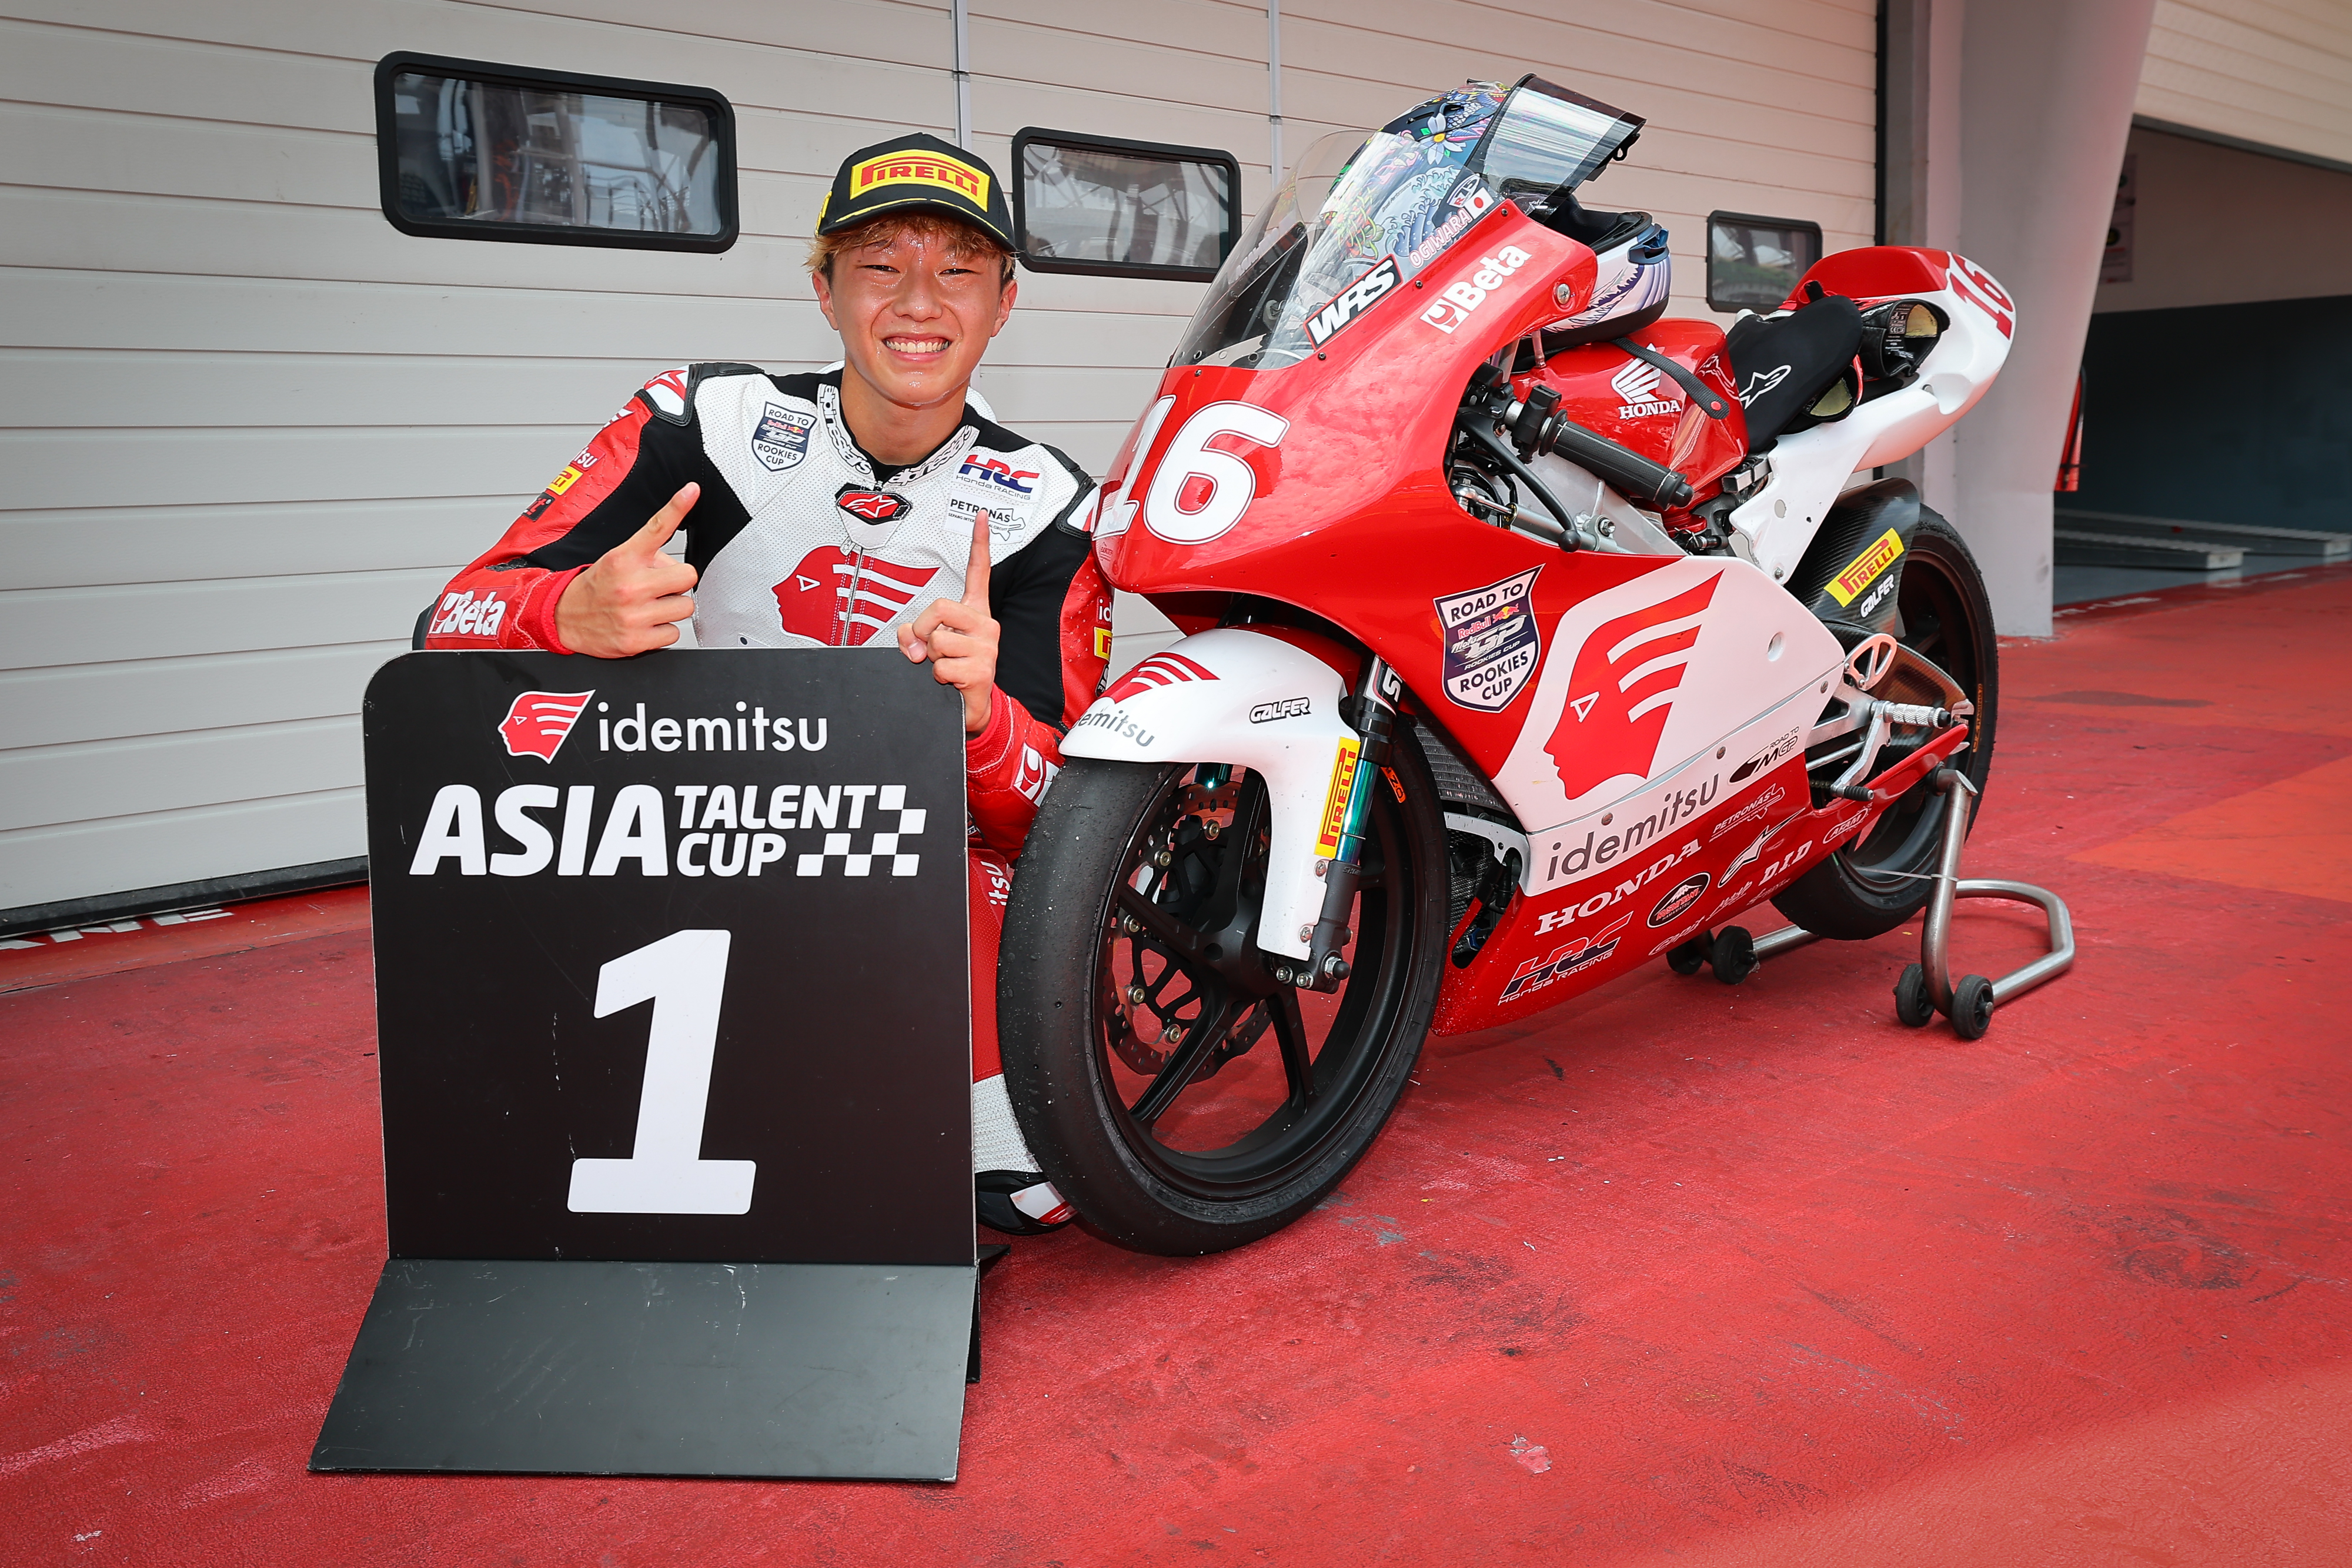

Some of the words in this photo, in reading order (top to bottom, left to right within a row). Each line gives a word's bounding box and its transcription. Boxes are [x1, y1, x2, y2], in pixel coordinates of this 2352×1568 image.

[860, 156, 980, 197] PIRELLI
[1409, 208, 1474, 268] OGIWARA
[1442, 245, 1532, 312] Beta
[1949, 252, 2013, 340] 16
[1308, 259, 1395, 345] WRS
[768, 409, 794, 421] ROAD
[797, 417, 808, 426] TO
[1618, 400, 1682, 419] HONDA
[757, 443, 798, 460] ROOKIES
[766, 456, 784, 465] CUP
[958, 454, 1040, 493] HRC
[1091, 393, 1291, 546] 16
[956, 475, 992, 489] Honda
[994, 486, 1031, 500] RACING
[1838, 539, 1895, 596] PIRELLI
[449, 590, 507, 636] Beta
[1451, 593, 1496, 623] ROAD
[1502, 583, 1523, 601] TO
[1860, 574, 1895, 618] GALFER
[1460, 650, 1528, 693] ROOKIES
[1464, 650, 1501, 670] ROOKIES
[1502, 640, 1521, 653] CUP
[1250, 697, 1311, 723] GALFER
[1482, 677, 1512, 700] CUP
[597, 701, 828, 753] idemitsu
[1769, 733, 1790, 750] ROAD
[1788, 726, 1799, 735] TO
[1319, 750, 1356, 846] PIRELLI
[1712, 791, 1773, 834] PETRONAS
[408, 784, 669, 877] ASIA
[674, 784, 877, 830] TALENT
[1547, 772, 1719, 882] idemitsu
[1830, 814, 1862, 838] AFAM
[676, 832, 786, 877] CUP
[1534, 838, 1702, 936] HONDA
[1499, 911, 1634, 999] HRC
[1497, 978, 1553, 1007] Honda
[1556, 950, 1614, 981] RACING
[566, 928, 757, 1215] 1
